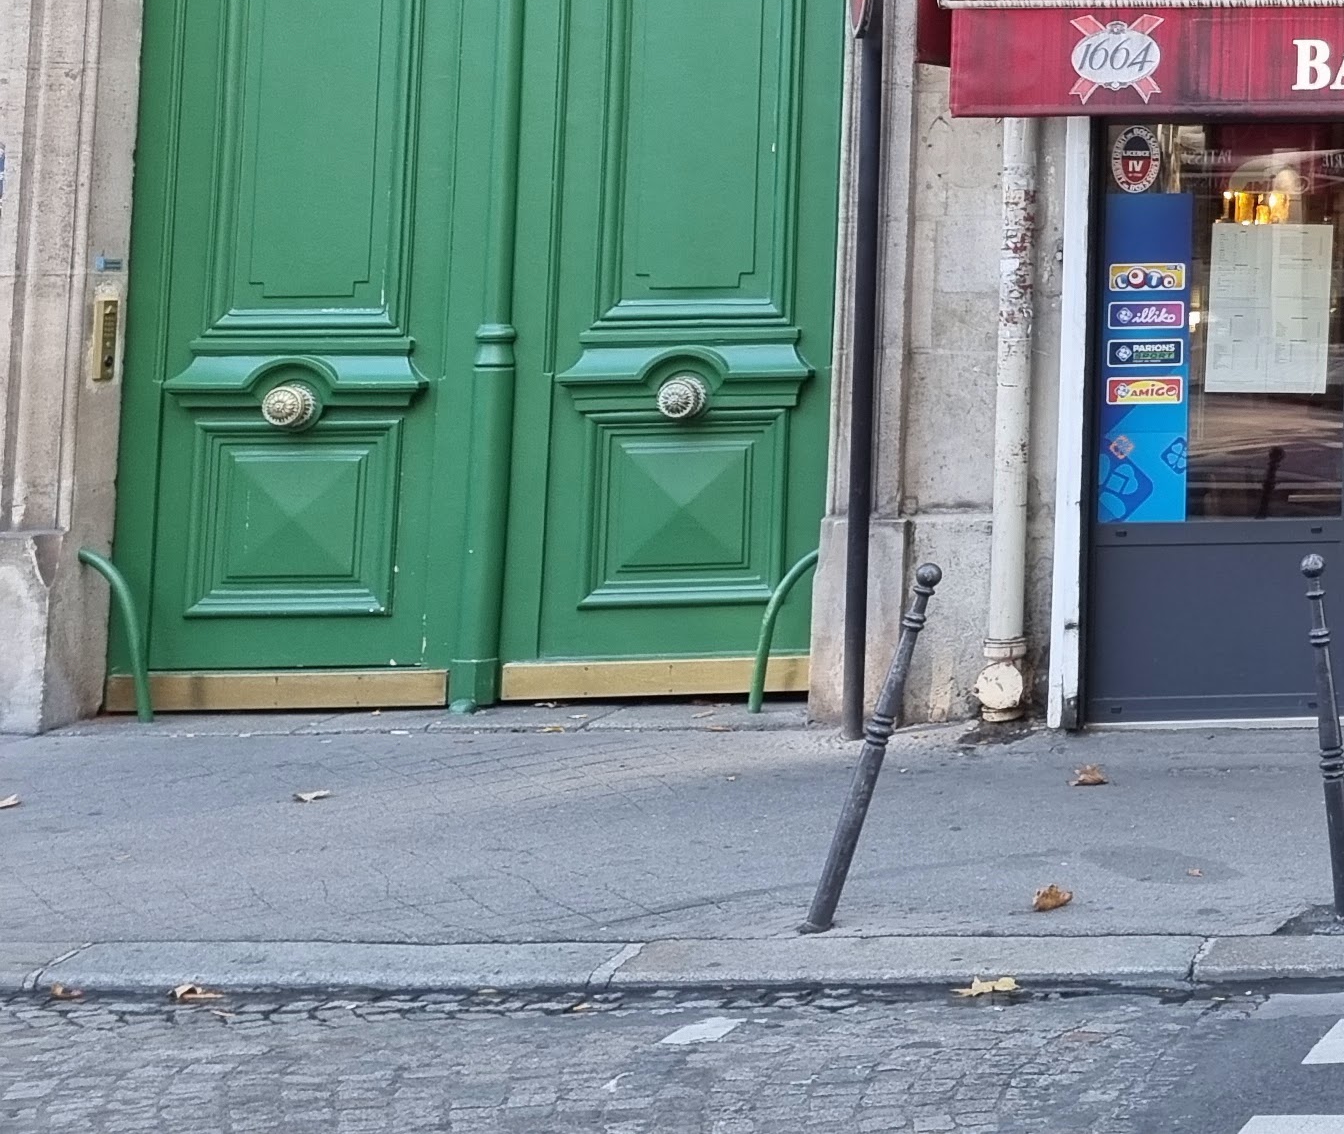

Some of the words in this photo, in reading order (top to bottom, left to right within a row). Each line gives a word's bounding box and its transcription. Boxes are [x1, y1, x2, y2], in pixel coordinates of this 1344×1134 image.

[1078, 37, 1156, 72] 1664
[1128, 160, 1143, 172] IV
[1116, 268, 1175, 289] LOTO
[1131, 306, 1176, 324] illiko
[1132, 344, 1176, 353] PARIONS
[1133, 352, 1175, 360] SPORT
[1130, 384, 1178, 398] AMIGO
